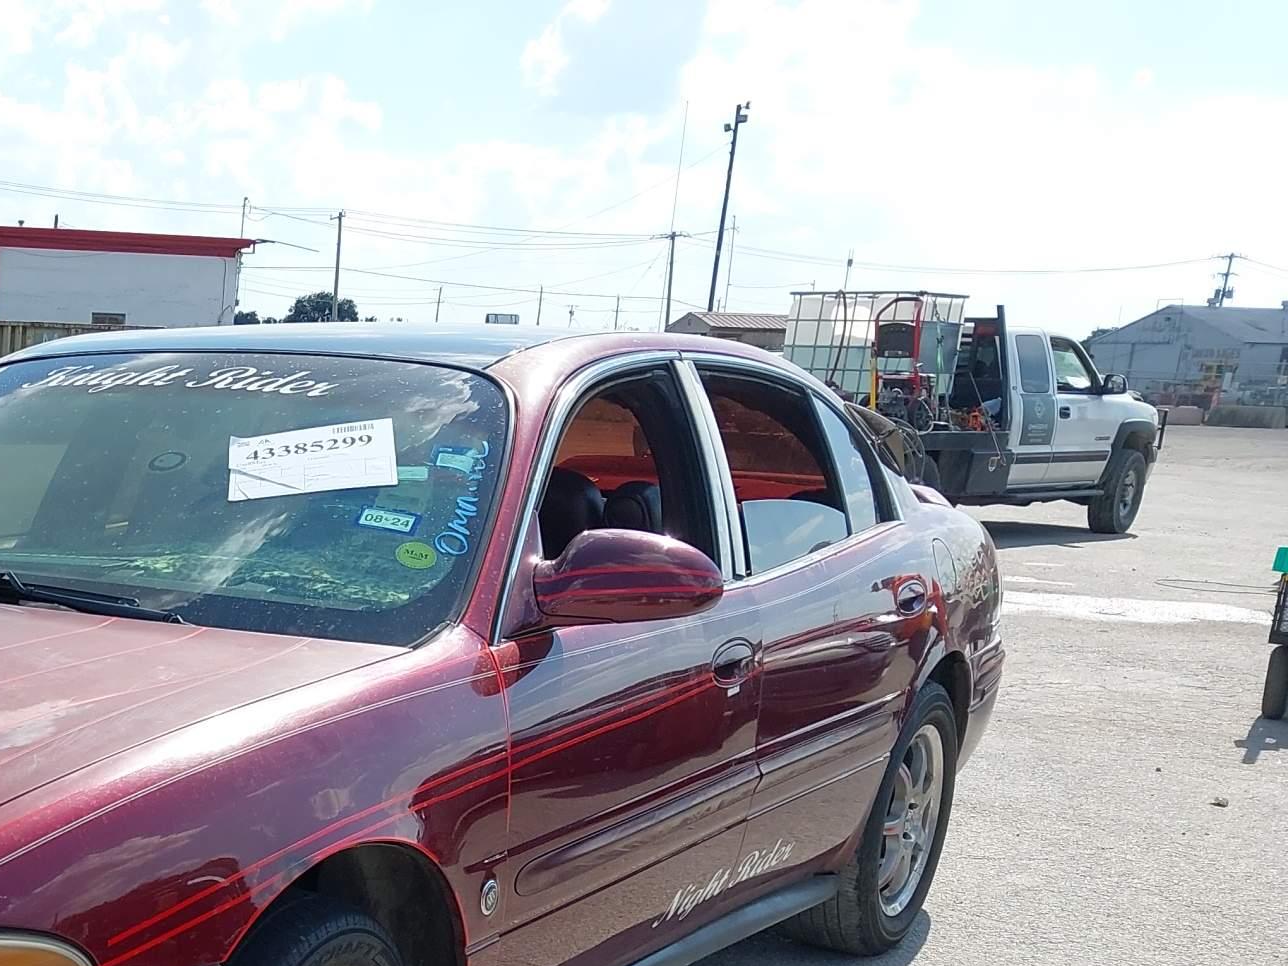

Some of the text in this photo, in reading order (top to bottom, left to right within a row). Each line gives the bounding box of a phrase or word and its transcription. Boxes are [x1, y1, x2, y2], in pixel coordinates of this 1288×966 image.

[22, 364, 339, 397] Knight Rider
[245, 433, 374, 463] 43385299
[652, 838, 796, 929] Night Rider
